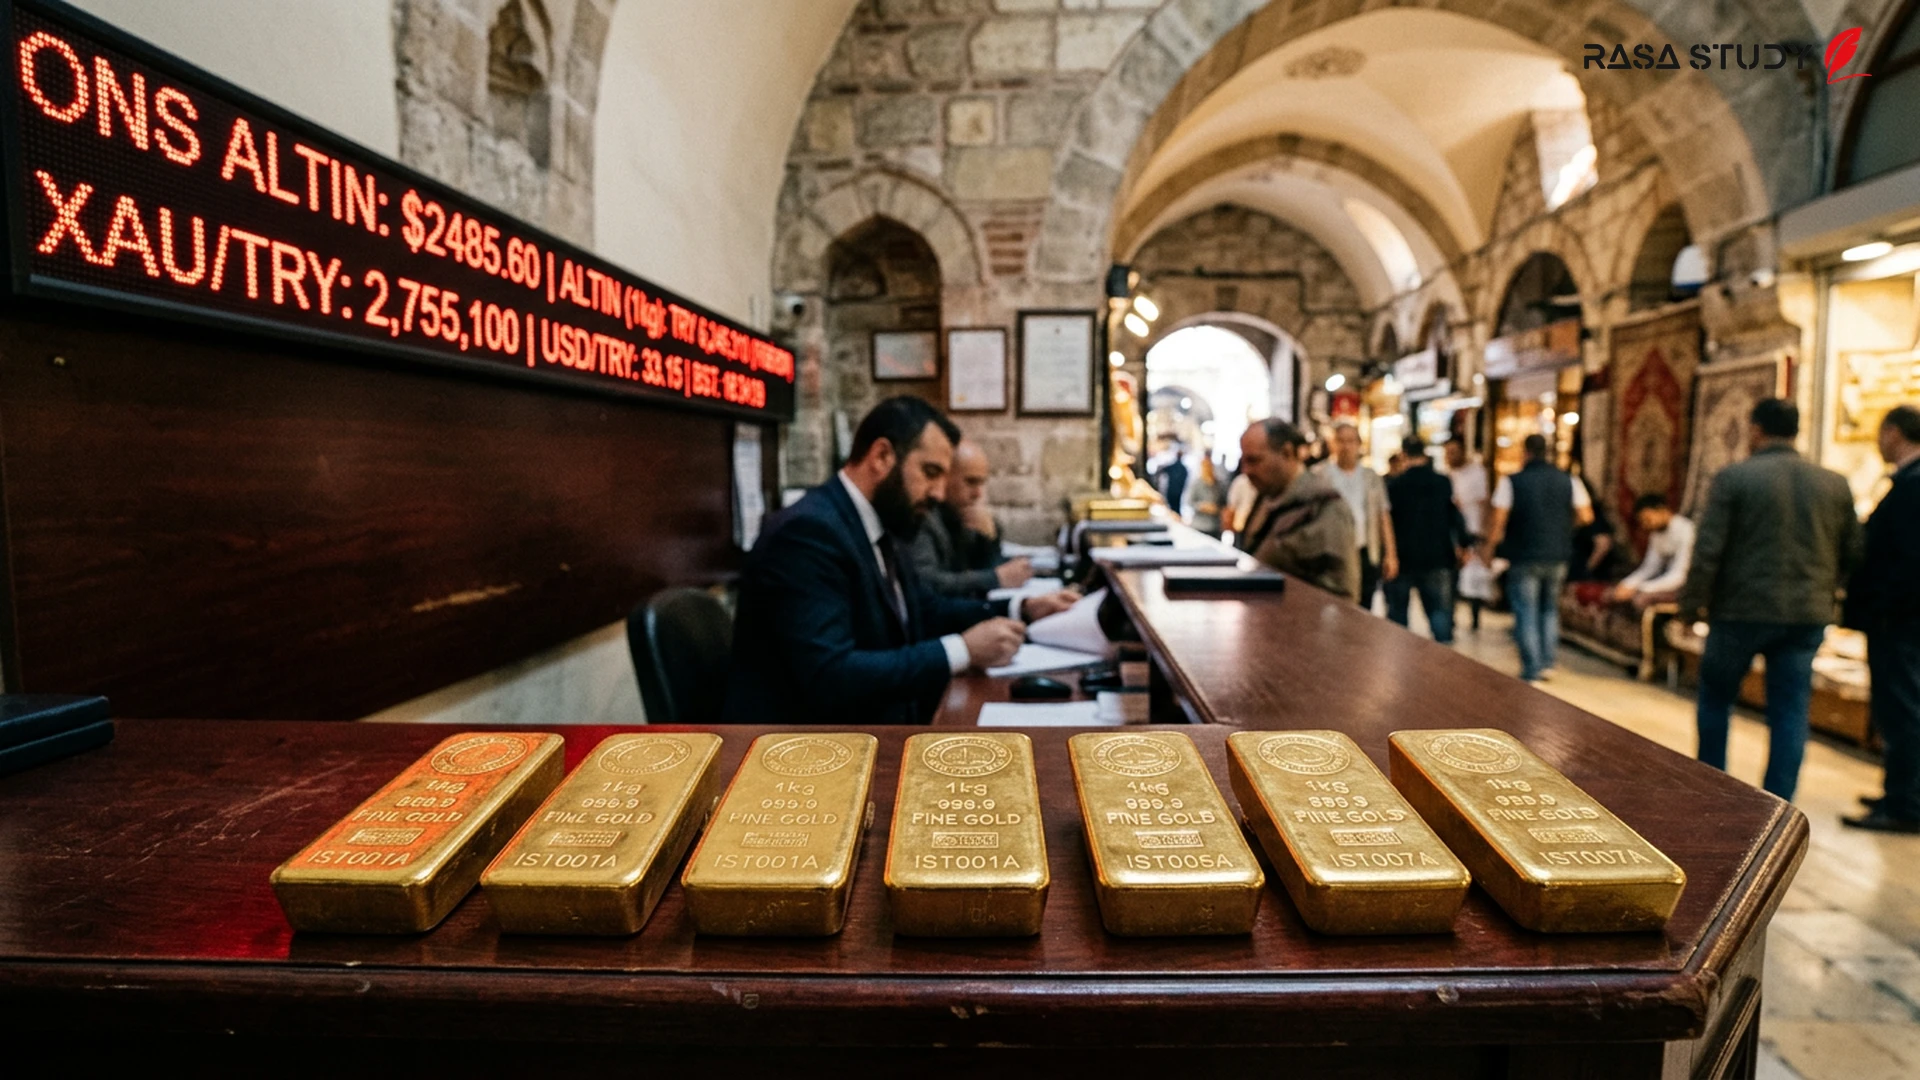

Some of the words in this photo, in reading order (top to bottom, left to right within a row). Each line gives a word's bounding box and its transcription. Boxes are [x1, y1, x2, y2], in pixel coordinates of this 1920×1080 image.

[20, 31, 201, 167] ONS
[221, 117, 390, 237] ALTIN:
[401, 189, 541, 290] $2485.60
[559, 259, 622, 319] ALTIN
[34, 169, 353, 319] XAU/TRY:
[364, 269, 520, 354] 2,755,100
[541, 318, 639, 381] USD/TRY:
[594, 812, 654, 825] GOLD
[728, 812, 774, 824] FINE
[780, 813, 837, 825] GOLD
[912, 812, 958, 825] FINE
[963, 813, 1021, 825] GOLD
[514, 853, 617, 868] IST001A
[713, 853, 820, 869] IST001A
[915, 854, 1021, 870] IST001A
[1329, 851, 1440, 868] IST007A
[1539, 849, 1653, 865] IST007A
